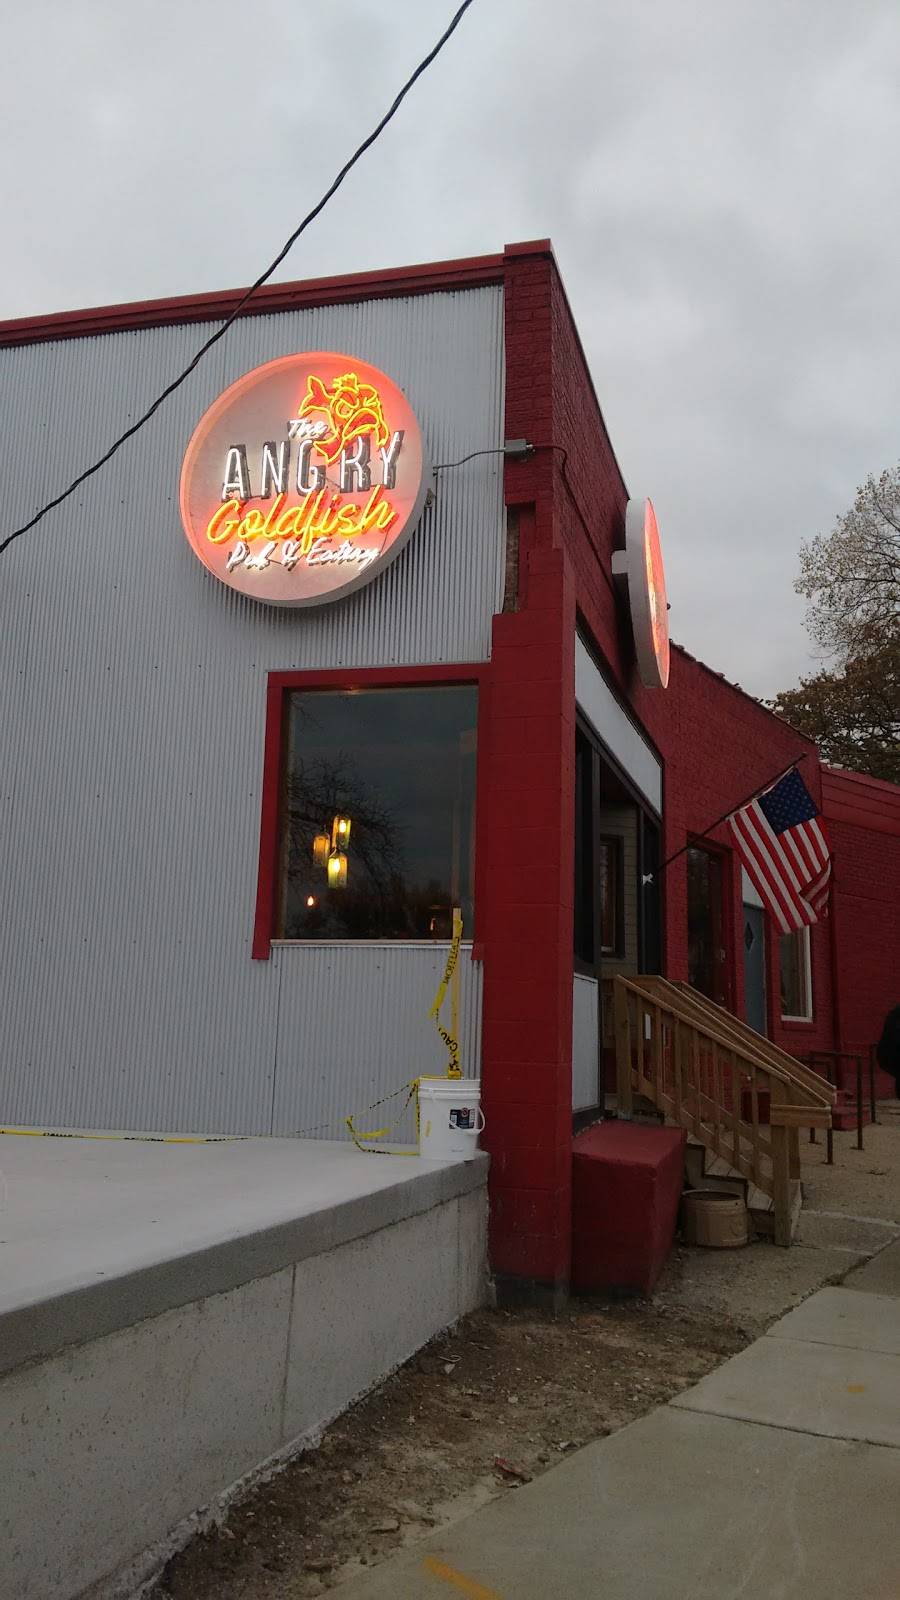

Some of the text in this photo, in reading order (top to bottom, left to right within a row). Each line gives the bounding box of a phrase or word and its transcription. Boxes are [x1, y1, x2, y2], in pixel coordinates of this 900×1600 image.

[288, 419, 329, 439] The
[221, 430, 405, 502] ANGRY
[207, 484, 399, 554] Goldfish
[226, 541, 278, 572] Pub
